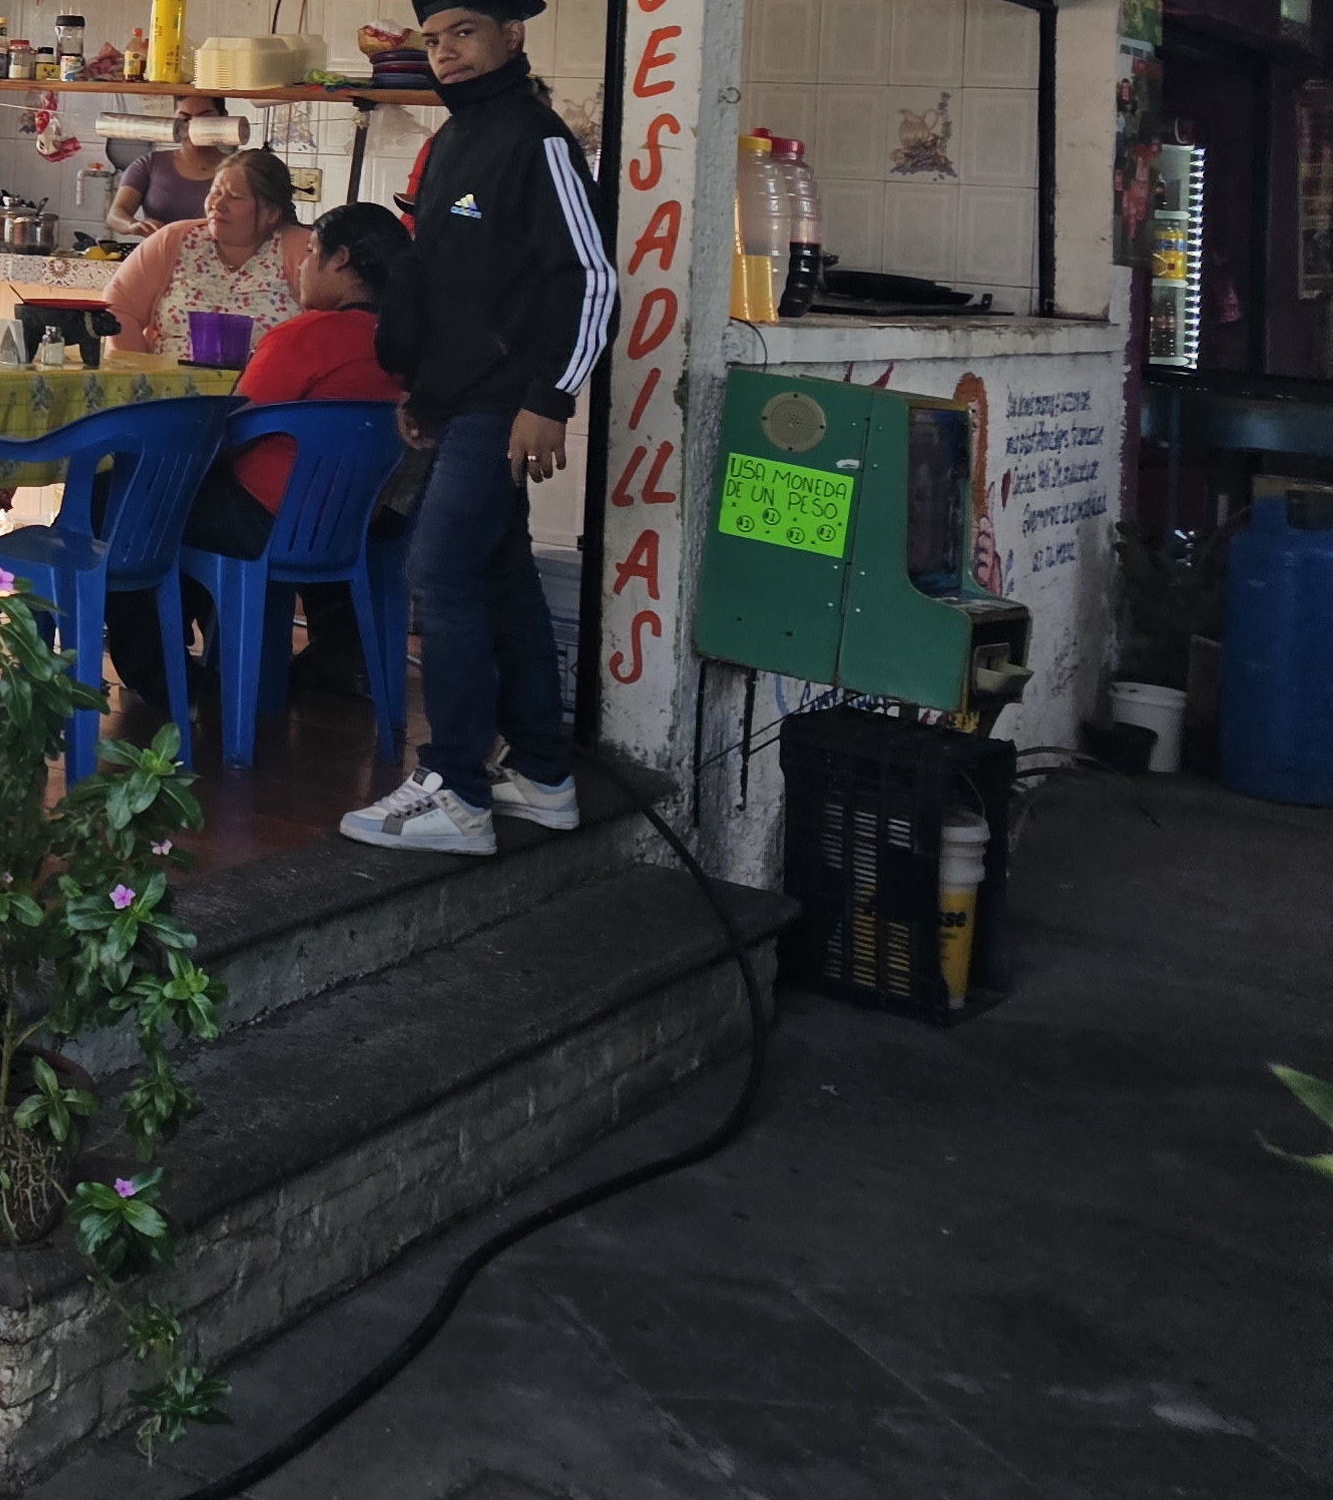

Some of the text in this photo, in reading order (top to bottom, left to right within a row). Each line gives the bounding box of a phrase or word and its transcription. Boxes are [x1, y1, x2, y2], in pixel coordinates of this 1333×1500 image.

[726, 479, 838, 519] DE UN PESO
[730, 458, 847, 500] USA MONEDA
